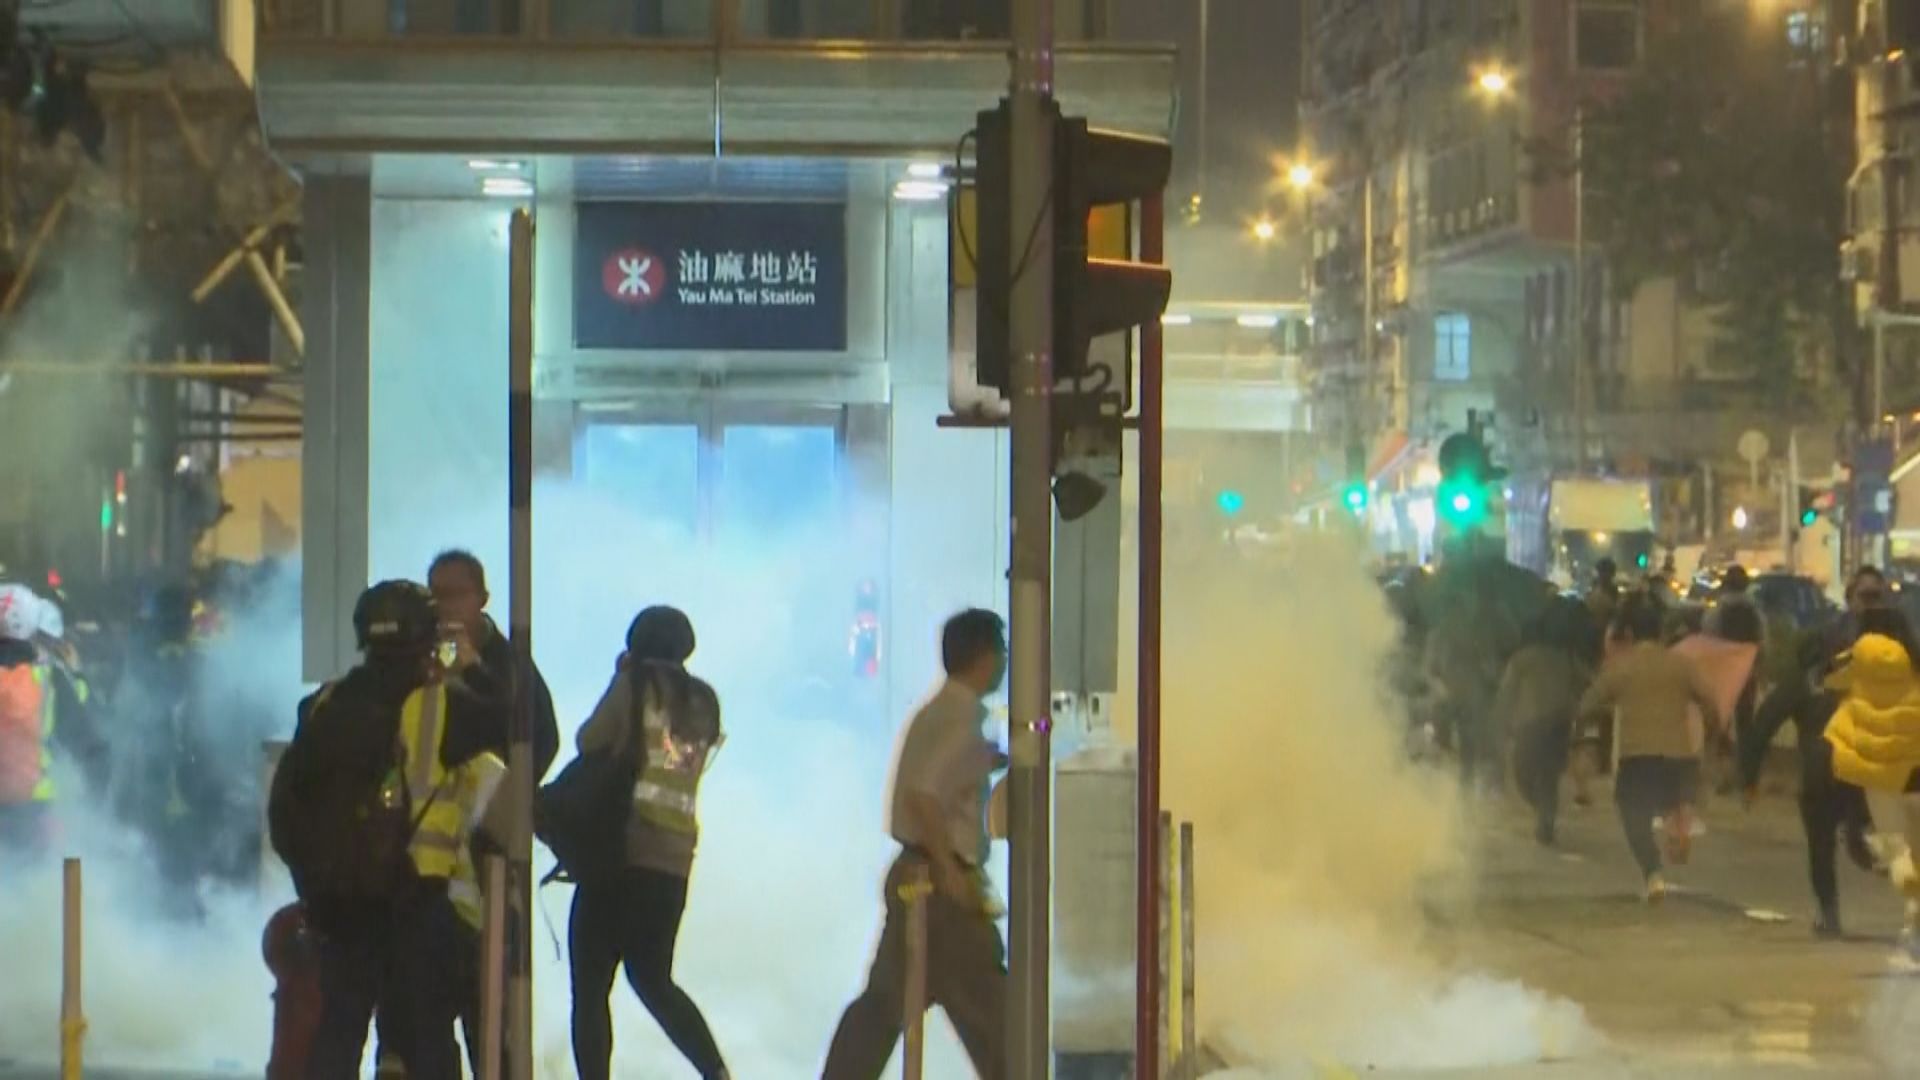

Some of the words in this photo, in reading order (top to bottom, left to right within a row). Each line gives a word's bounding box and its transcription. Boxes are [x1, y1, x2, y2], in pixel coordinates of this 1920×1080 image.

[678, 250, 817, 284] 油麻地站
[678, 288, 706, 304] Yau
[710, 288, 733, 304] Ma
[736, 288, 757, 304] Tei
[761, 288, 815, 305] Station
